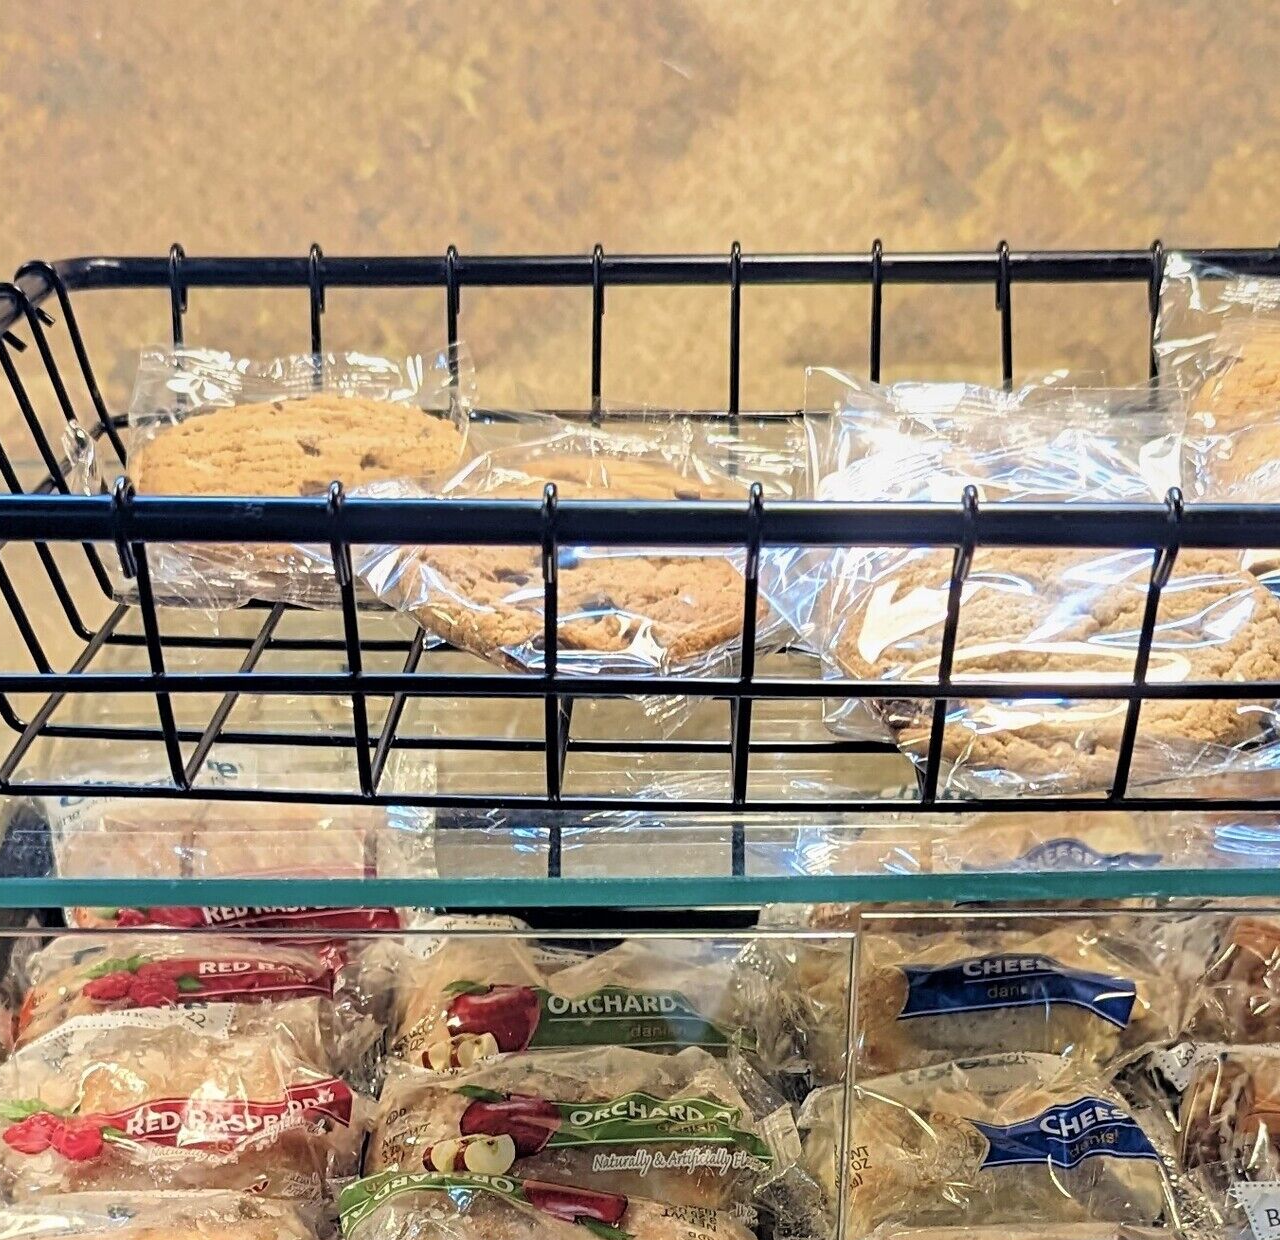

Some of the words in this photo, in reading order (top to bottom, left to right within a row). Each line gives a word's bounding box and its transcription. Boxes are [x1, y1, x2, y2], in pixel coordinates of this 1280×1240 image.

[199, 961, 251, 975] RED
[547, 995, 677, 1015] ORCHARD
[125, 1110, 181, 1136] RED
[569, 1100, 705, 1127] ORCHARD
[592, 1151, 651, 1176] Naturally
[653, 1153, 666, 1170] &
[667, 1148, 734, 1177] Artificially
